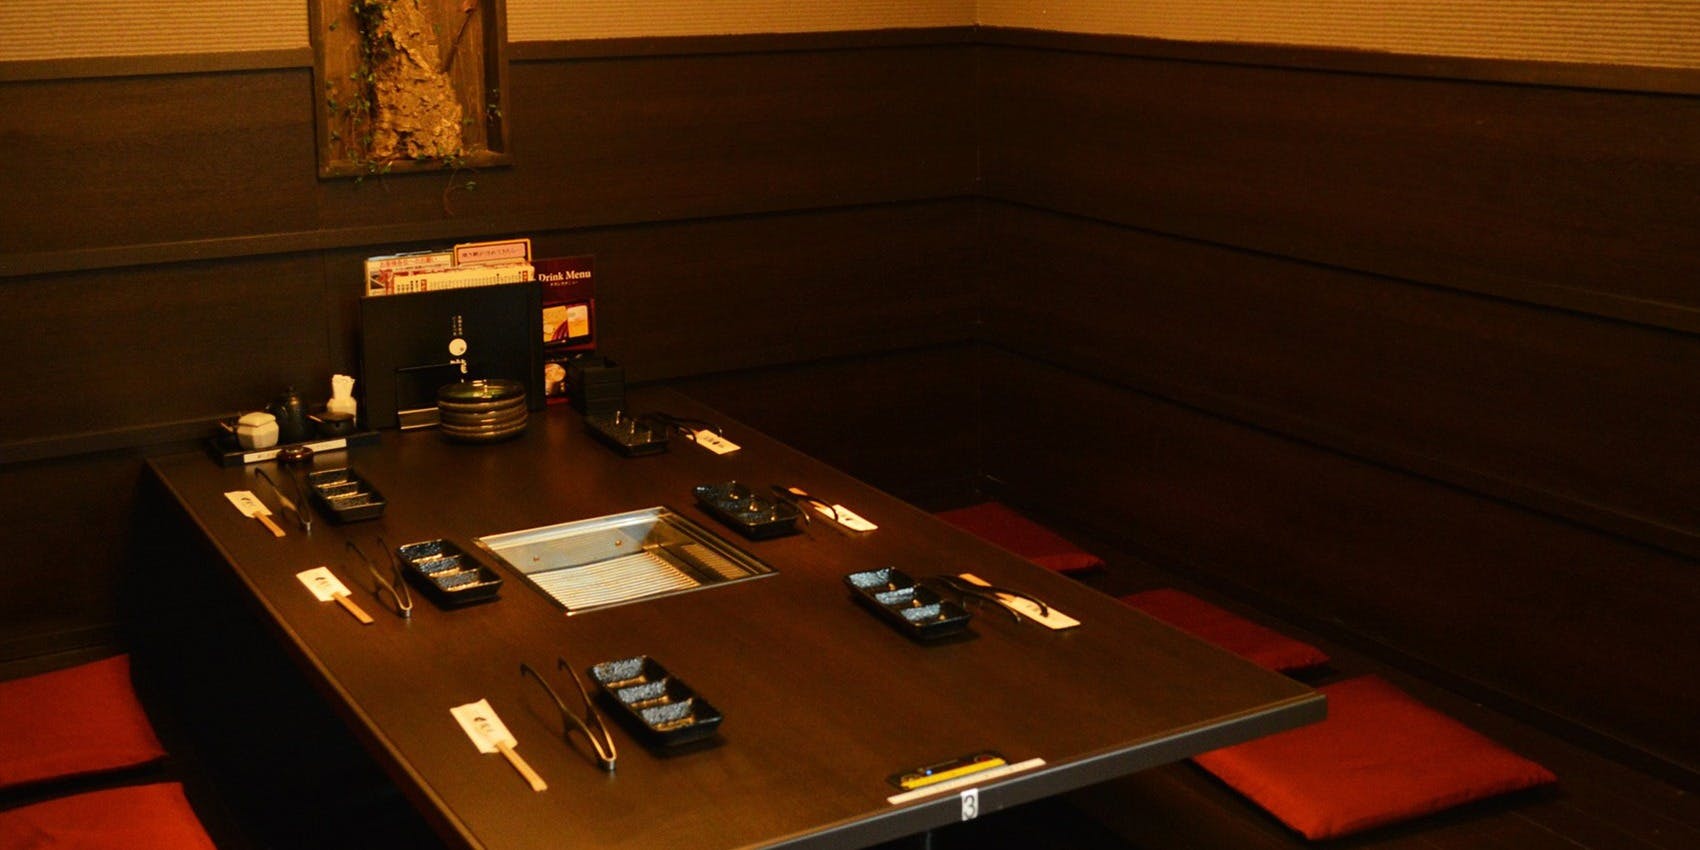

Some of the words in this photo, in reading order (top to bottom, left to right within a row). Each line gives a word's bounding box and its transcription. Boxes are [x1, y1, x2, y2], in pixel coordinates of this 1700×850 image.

[538, 271, 564, 281] Drink
[565, 270, 592, 280] Menu
[964, 794, 976, 818] 3
